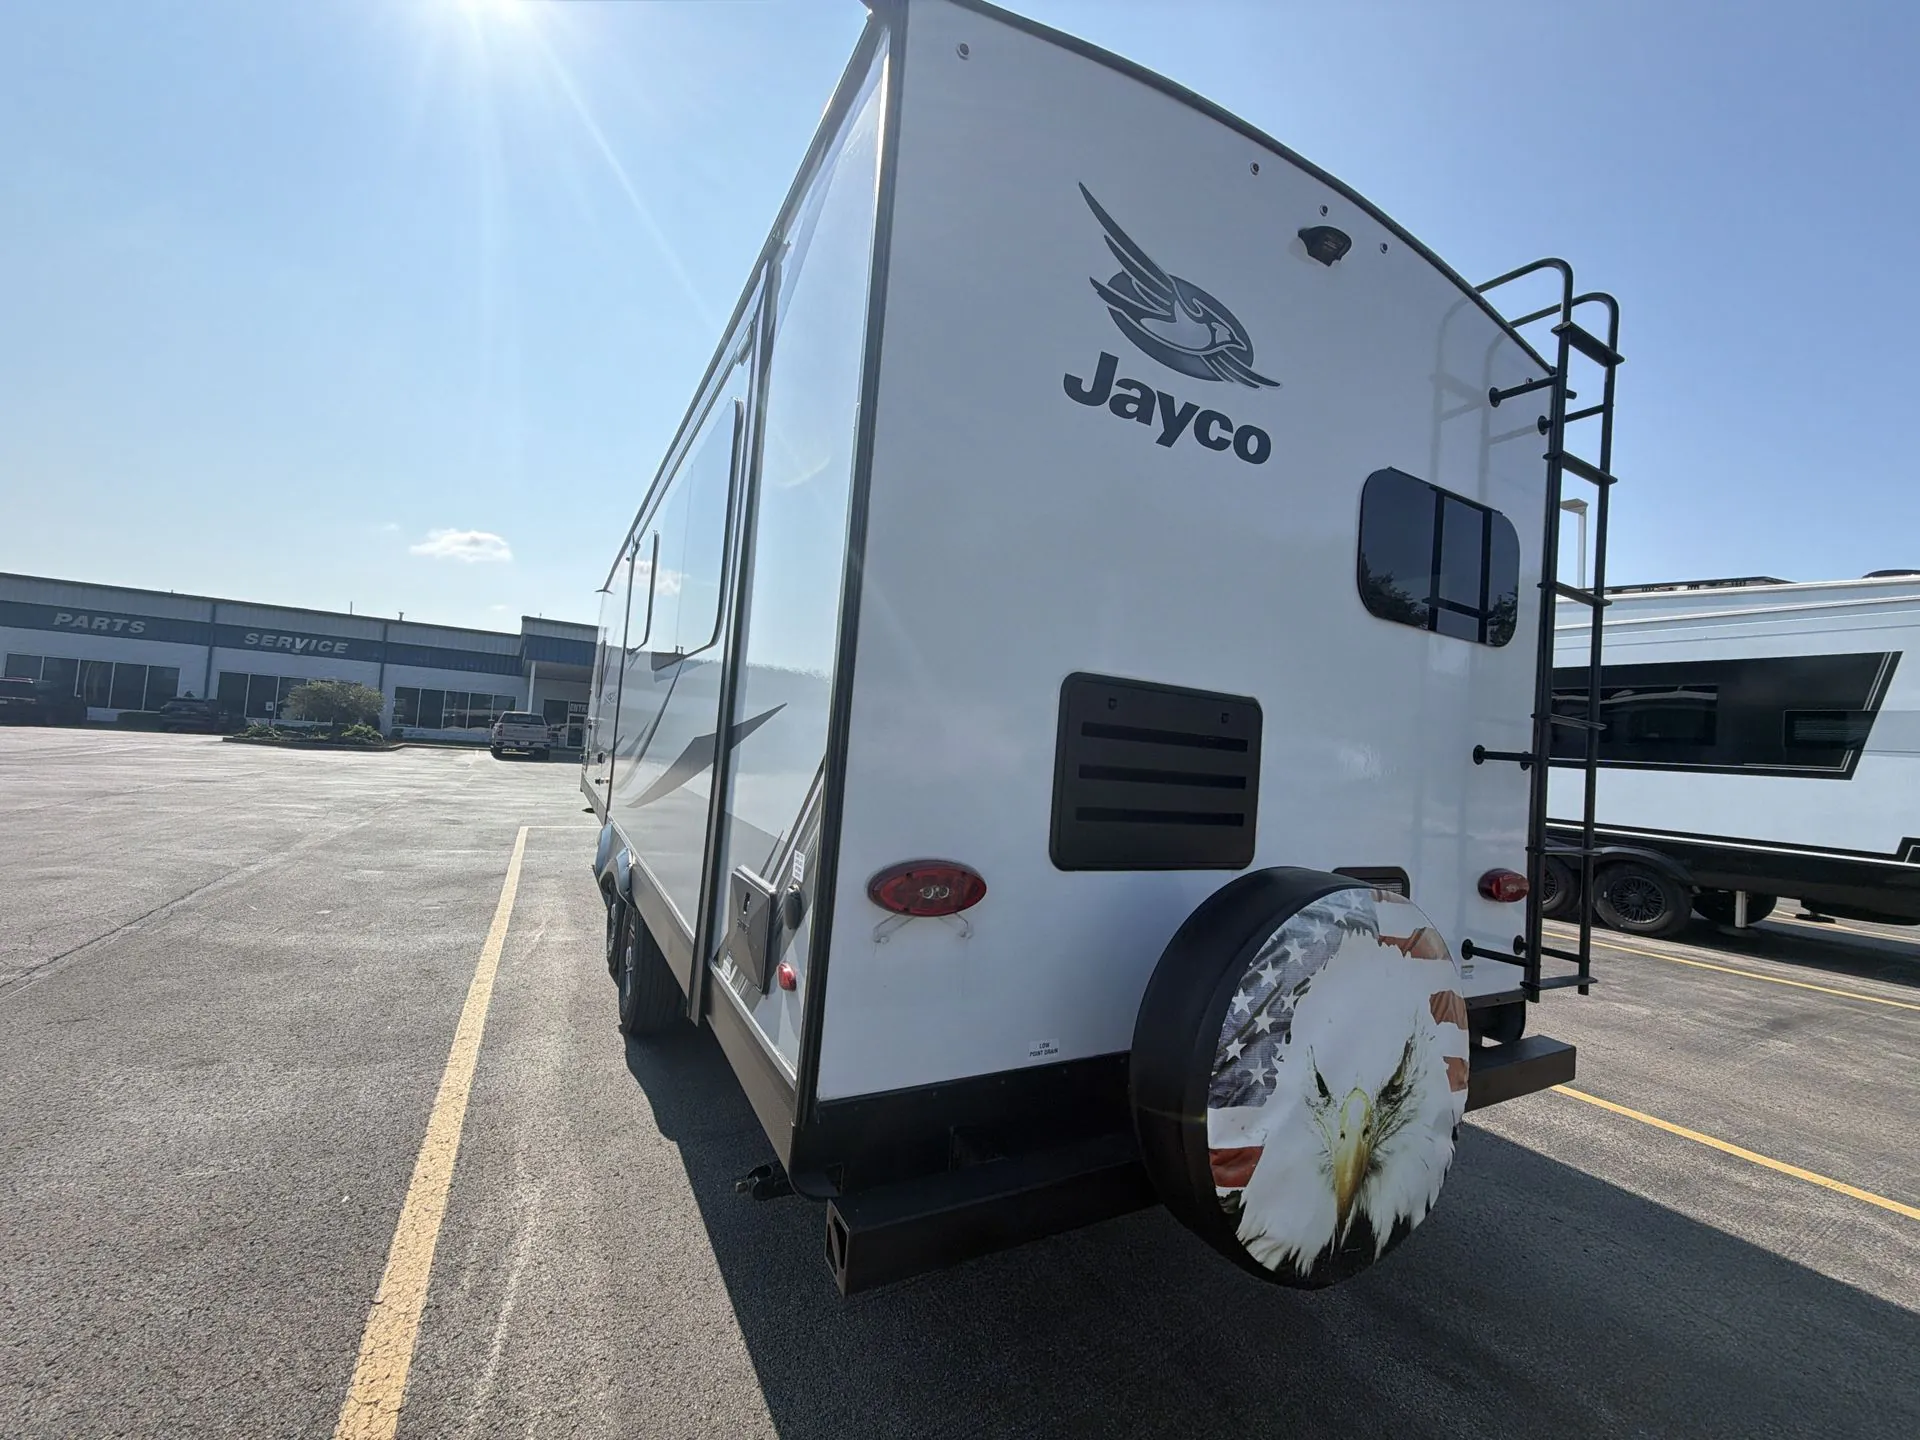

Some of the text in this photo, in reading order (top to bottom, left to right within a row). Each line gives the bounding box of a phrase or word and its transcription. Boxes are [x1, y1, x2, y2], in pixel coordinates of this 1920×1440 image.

[1063, 351, 1272, 465] Jayco
[53, 612, 146, 634] PARTS
[244, 633, 349, 654] SERVICE
[570, 703, 588, 713] ENTR
[1029, 1049, 1043, 1057] POINT
